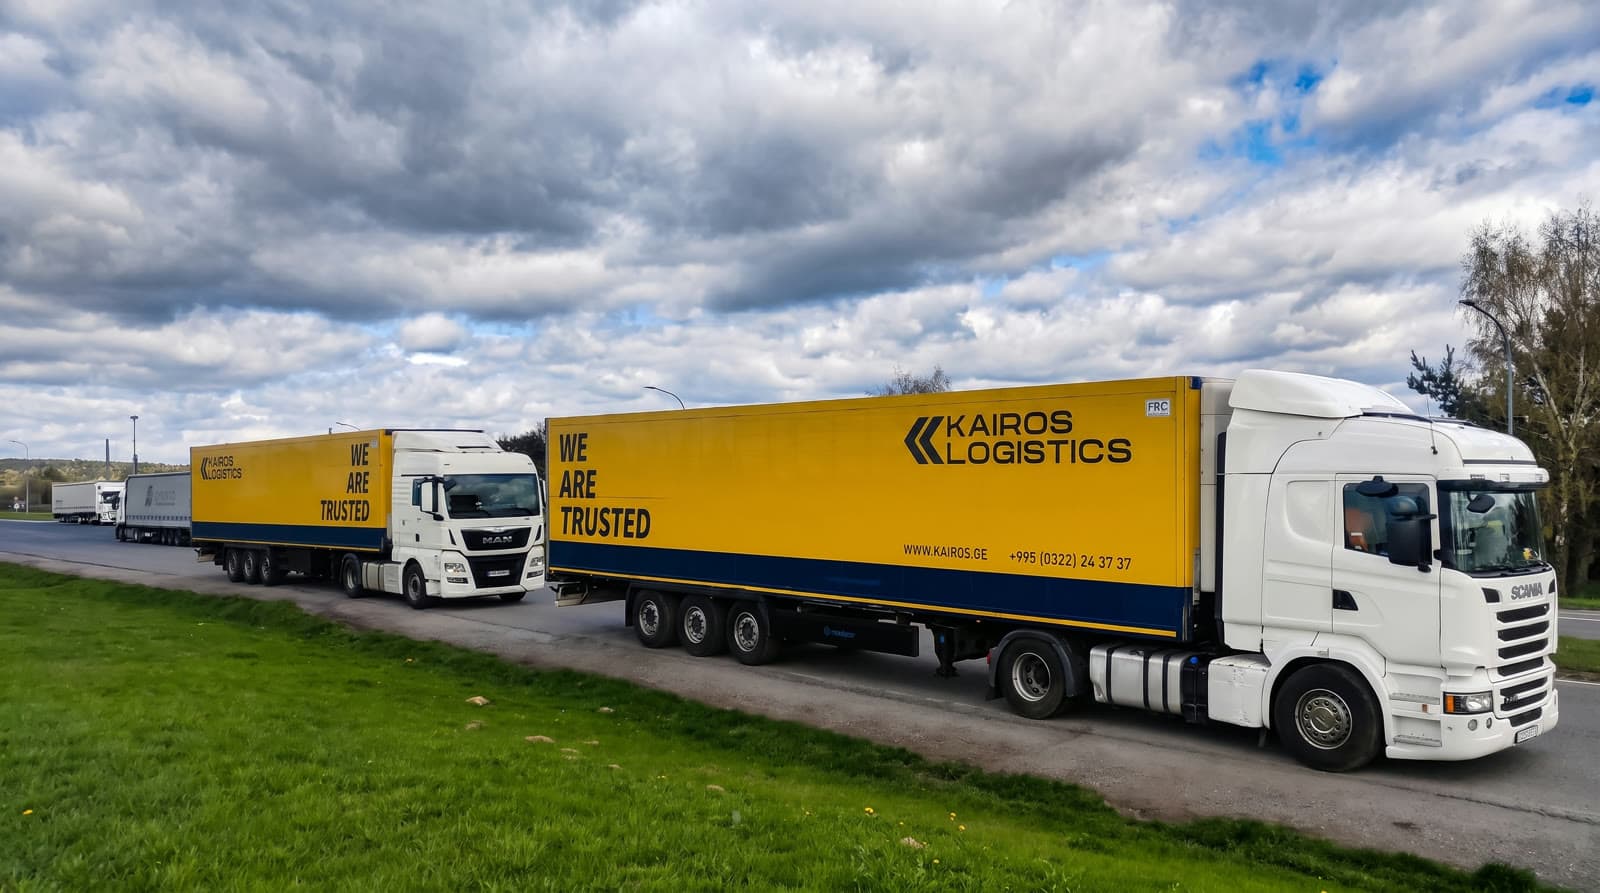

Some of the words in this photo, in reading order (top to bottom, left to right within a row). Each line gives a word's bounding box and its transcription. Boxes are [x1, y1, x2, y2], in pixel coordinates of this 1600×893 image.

[1148, 401, 1168, 411] FRC
[946, 410, 1073, 437] KAIROS
[351, 443, 369, 466] WE
[559, 433, 588, 462] WE
[946, 438, 1132, 465] LOGISTICS
[208, 456, 233, 467] KAIROS
[208, 468, 242, 480] LOGISTICS
[346, 471, 369, 494] ARE
[559, 469, 597, 499] ARE
[320, 499, 370, 521] TRUSTED
[560, 506, 651, 539] TRUSTED
[482, 536, 512, 544] MAN
[903, 543, 988, 560] WWW.KAIROS.GE
[1009, 551, 1036, 564] +995
[1040, 551, 1076, 569] (0322)
[1080, 554, 1095, 568] 24
[1098, 556, 1113, 569] 37
[1116, 557, 1132, 570] 37
[1510, 581, 1543, 600] SCANIA
